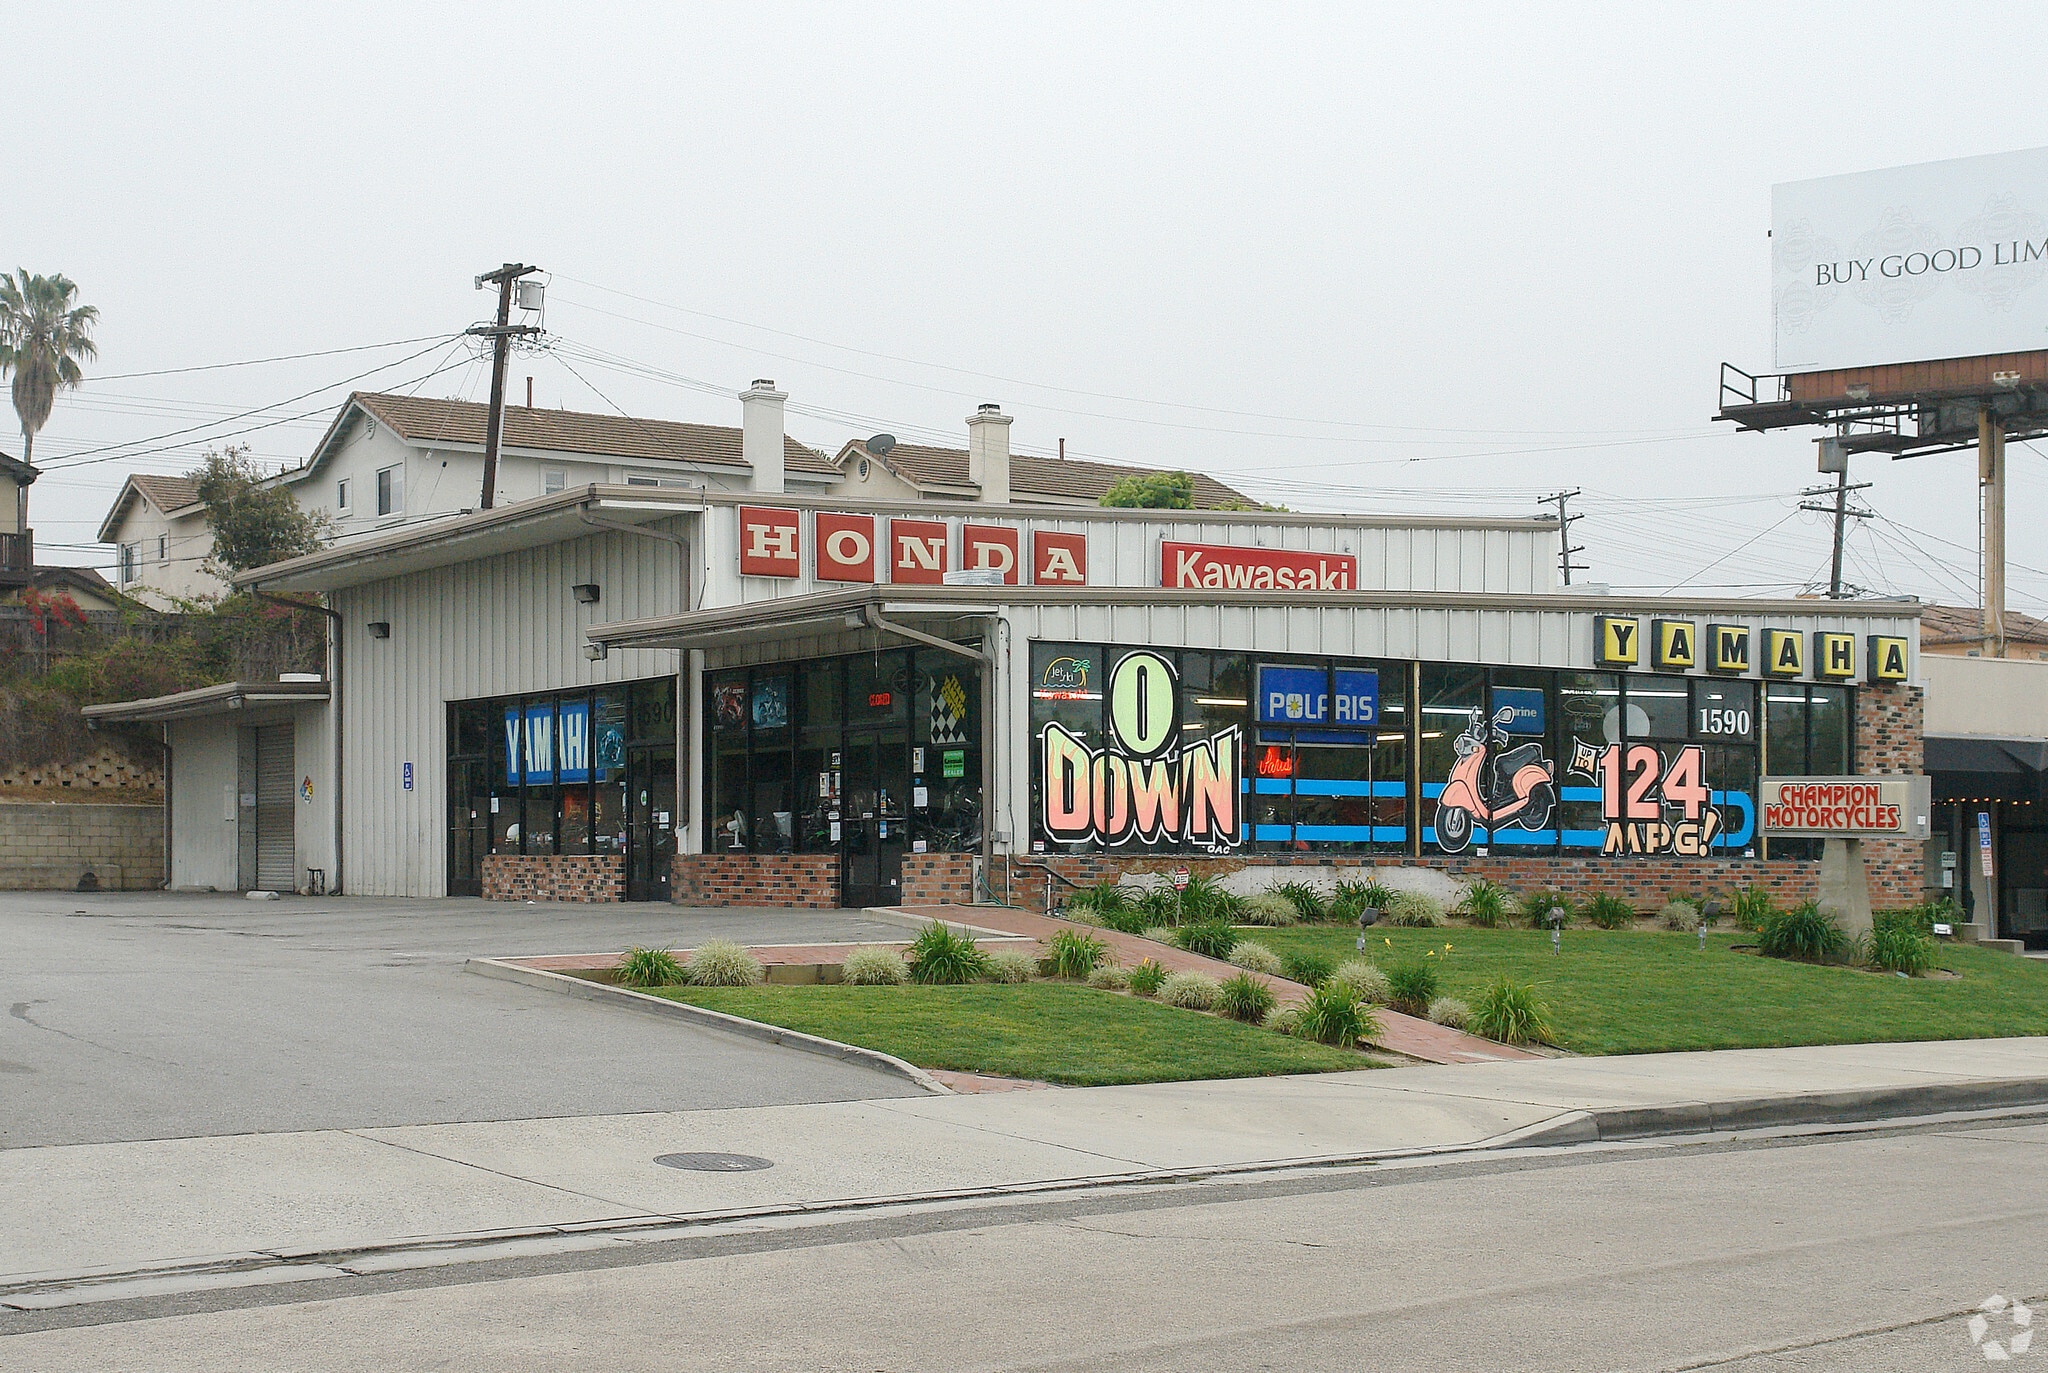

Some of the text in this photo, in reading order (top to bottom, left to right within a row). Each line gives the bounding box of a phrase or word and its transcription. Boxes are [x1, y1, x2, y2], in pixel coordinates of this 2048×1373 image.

[1815, 257, 1874, 286] BUY
[1880, 246, 1982, 278] GOOD
[747, 523, 1084, 582] HONDA
[1176, 550, 1348, 590] Kawasaki
[1611, 624, 1904, 674] YAMAHA
[1269, 692, 1373, 721] POLARIS
[1699, 708, 1750, 735] 1590
[1577, 756, 1590, 768] TO
[1581, 747, 1592, 758] UP
[1045, 727, 1237, 839] DOWN
[1600, 744, 1707, 820] 124
[1604, 811, 1718, 857] MPG!
[1766, 805, 1899, 829] MOTORCYCLES
